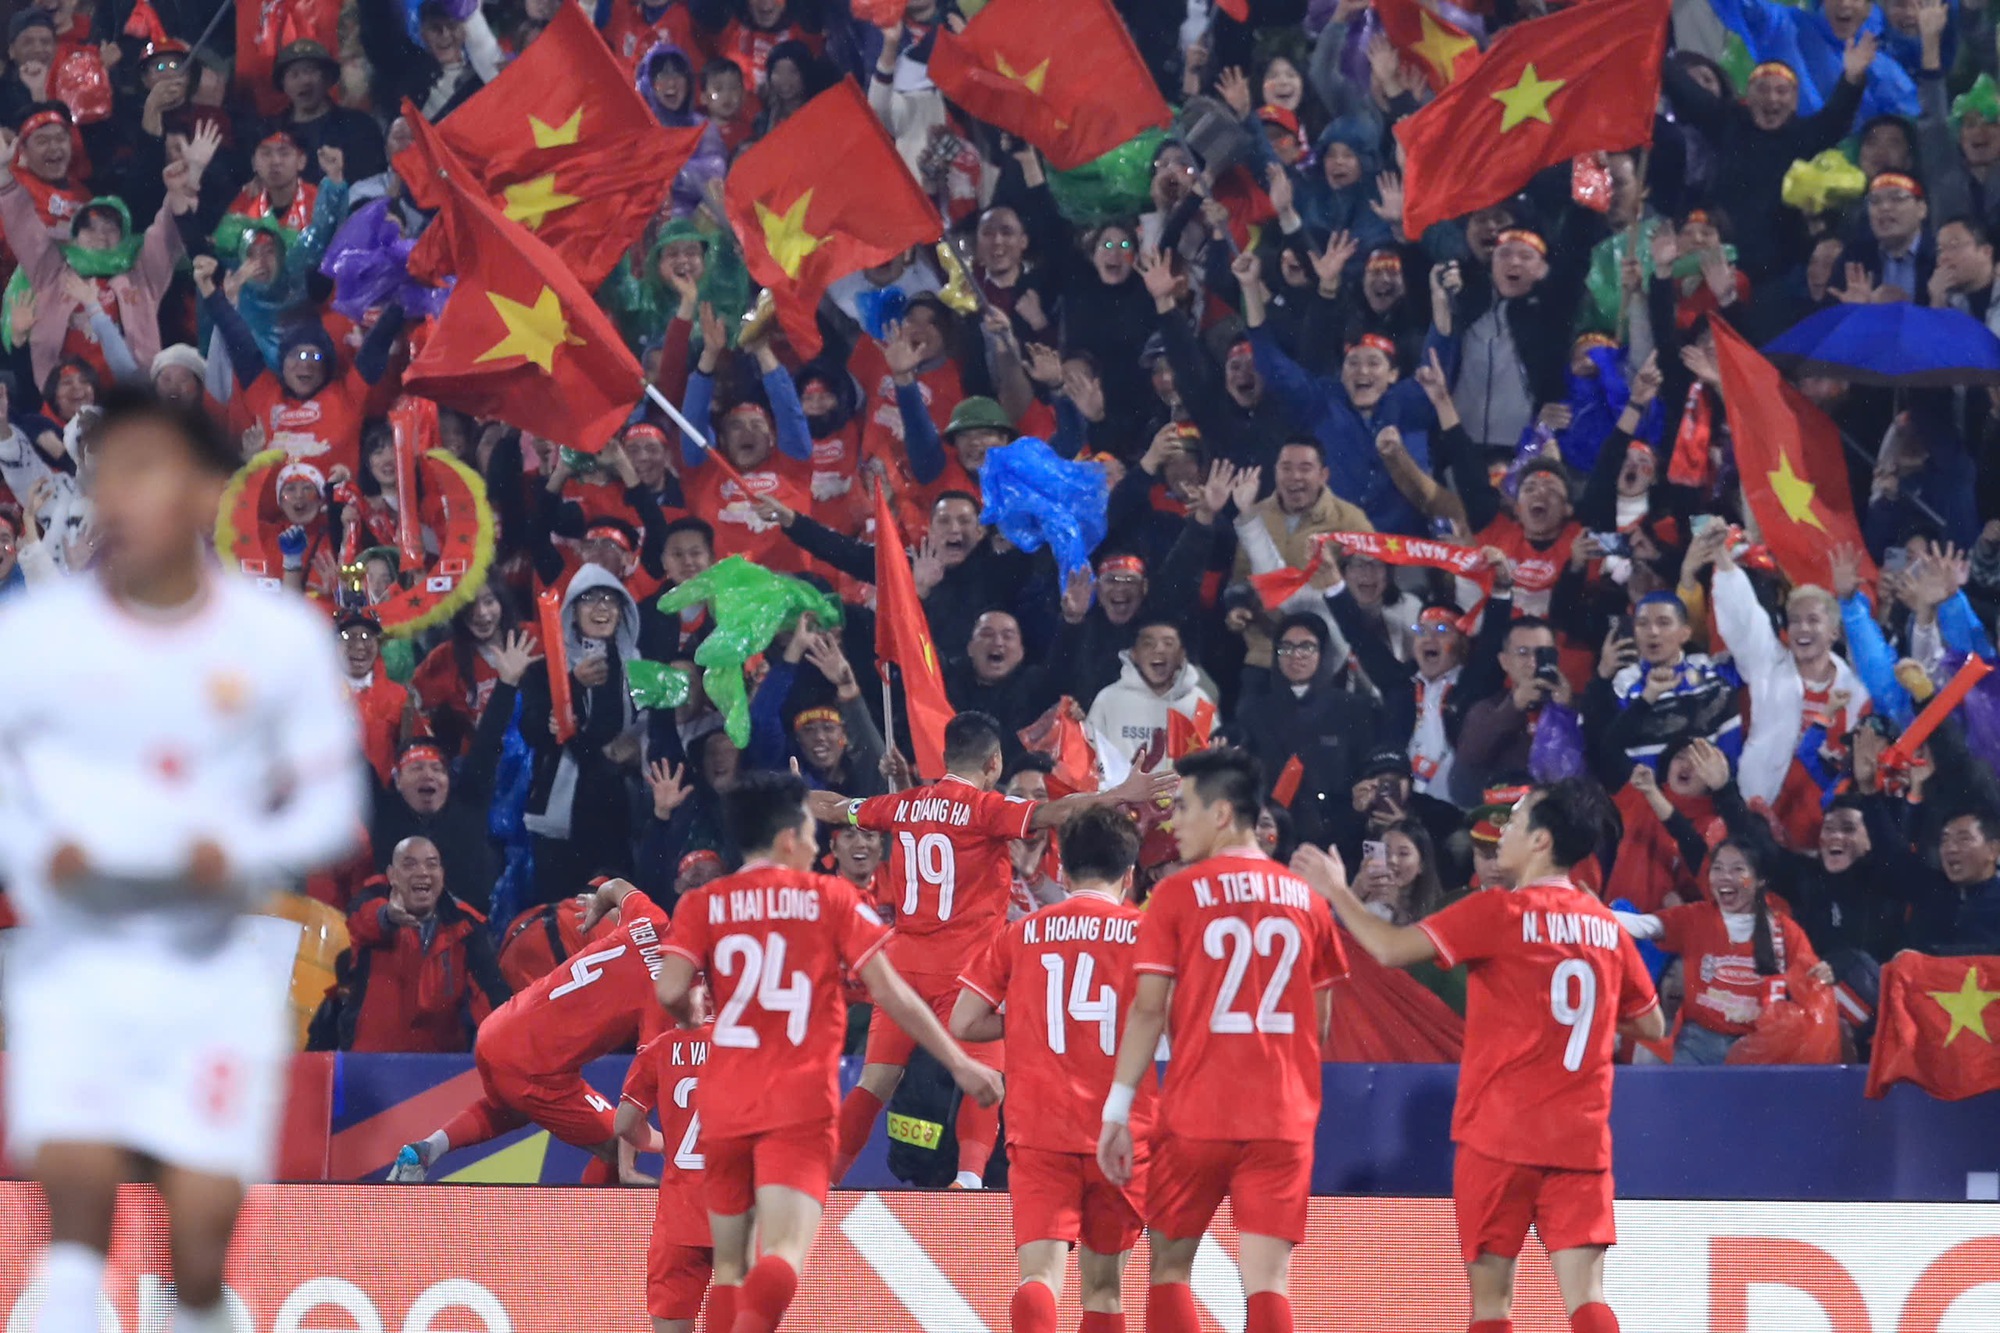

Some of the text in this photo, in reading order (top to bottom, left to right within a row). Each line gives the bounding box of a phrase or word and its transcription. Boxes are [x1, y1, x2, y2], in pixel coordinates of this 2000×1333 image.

[1405, 539, 1449, 561] NAM
[893, 799, 909, 822] N.
[899, 831, 955, 921] 19
[1193, 871, 1311, 912] N. TIEN LINH
[730, 888, 763, 922] HAI
[766, 887, 819, 922] LONG
[629, 922, 659, 946] TIEN
[1023, 916, 1138, 945] N. HOANG DUC
[1523, 910, 1619, 951] N. VAN TOAN
[549, 944, 627, 1001] 4
[712, 931, 812, 1048] 24
[1203, 916, 1301, 1034] 22
[1041, 952, 1117, 1056] 14
[1551, 958, 1597, 1072] 9
[671, 1041, 711, 1066] K. VA
